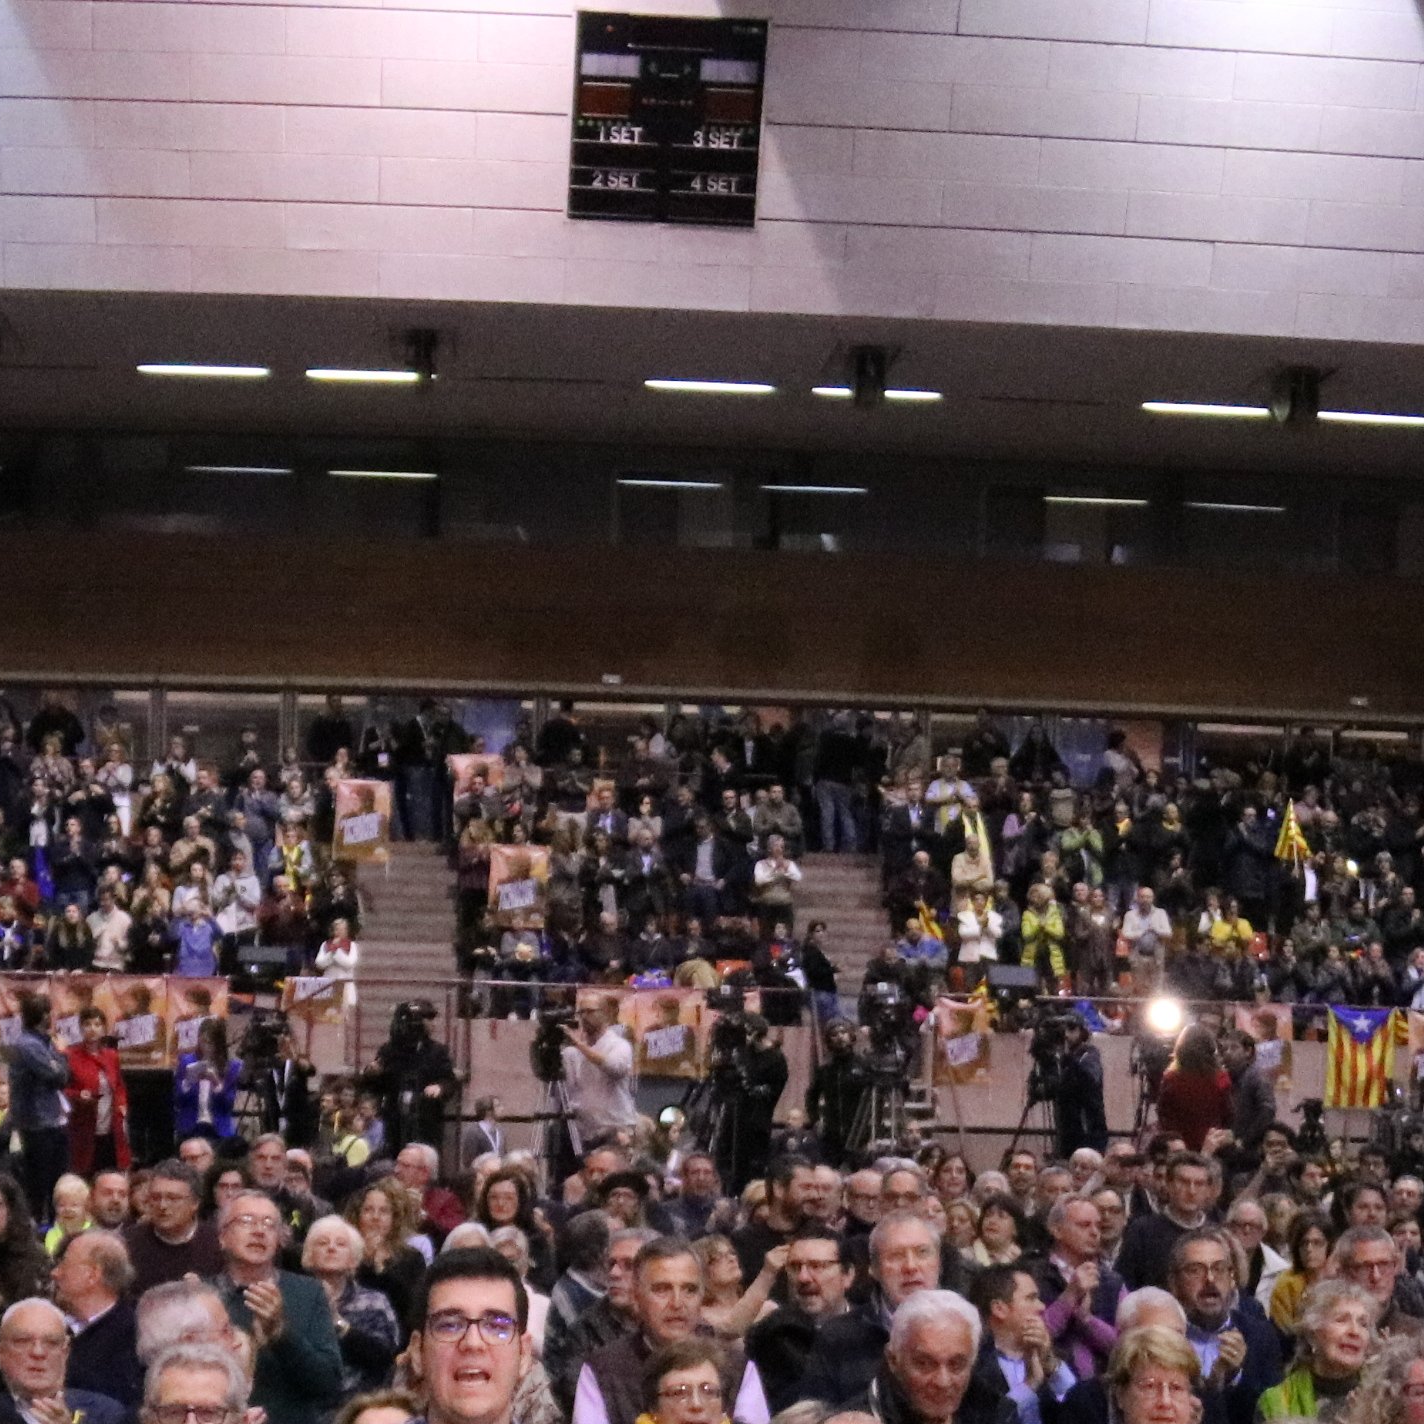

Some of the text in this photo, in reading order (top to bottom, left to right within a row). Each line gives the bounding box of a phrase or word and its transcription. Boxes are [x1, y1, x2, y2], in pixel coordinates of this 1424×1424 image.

[609, 126, 643, 144] SET
[692, 131, 742, 149] 3 SET
[591, 171, 640, 189] 2 SET
[690, 175, 739, 193] 4 SET
